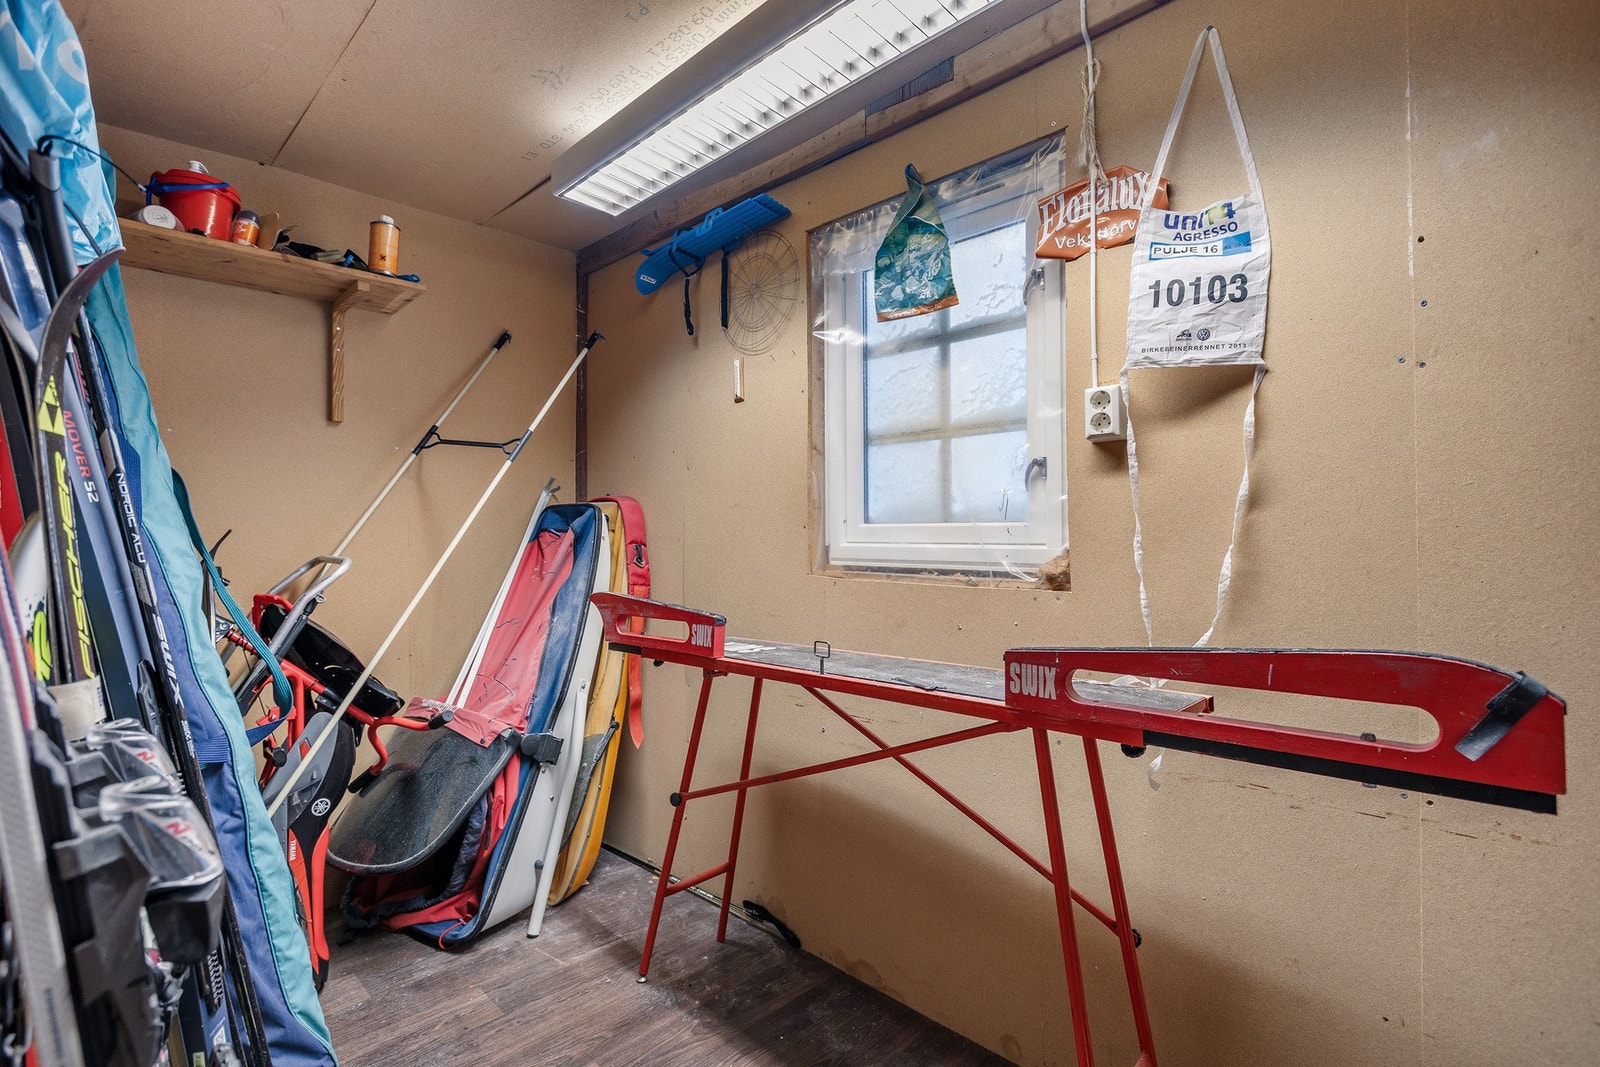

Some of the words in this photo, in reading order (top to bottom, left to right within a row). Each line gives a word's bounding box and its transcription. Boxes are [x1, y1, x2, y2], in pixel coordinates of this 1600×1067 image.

[1173, 221, 1238, 242] AGRESSO
[1153, 246, 1198, 255] PULJE
[1203, 244, 1218, 254] 16
[1148, 273, 1249, 308] 10103
[1141, 343, 1226, 354] BIRKEBEINERRENNET
[62, 409, 92, 479] MOVER
[83, 480, 100, 504] 52
[115, 472, 137, 527] NORDIC
[131, 532, 146, 563] ALU
[54, 450, 97, 680] FISCHER
[691, 622, 713, 648] SWIX
[1009, 661, 1057, 700] SWIX
